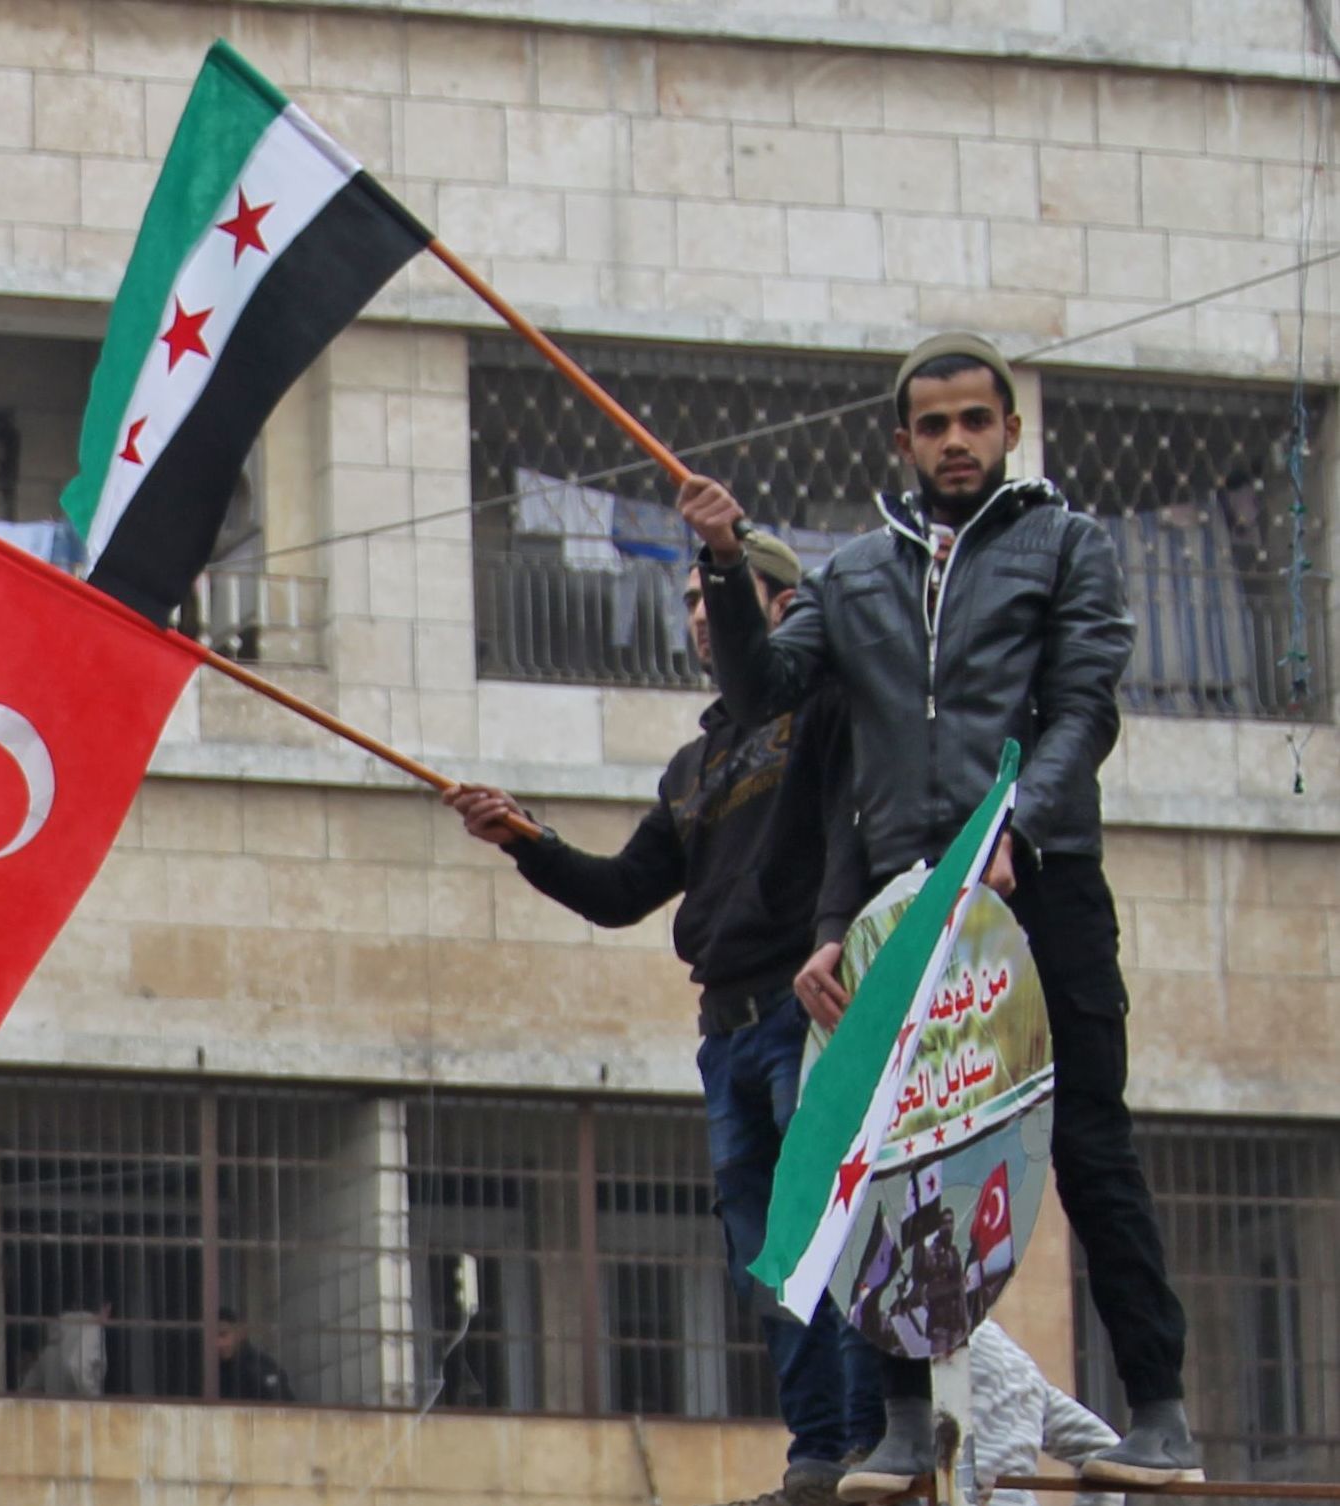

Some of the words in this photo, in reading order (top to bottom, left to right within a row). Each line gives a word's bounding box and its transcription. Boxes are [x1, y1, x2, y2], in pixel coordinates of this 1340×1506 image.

[980, 967, 1009, 1014] من
[887, 1070, 932, 1132] الحر
[937, 1047, 995, 1108] سنابل
